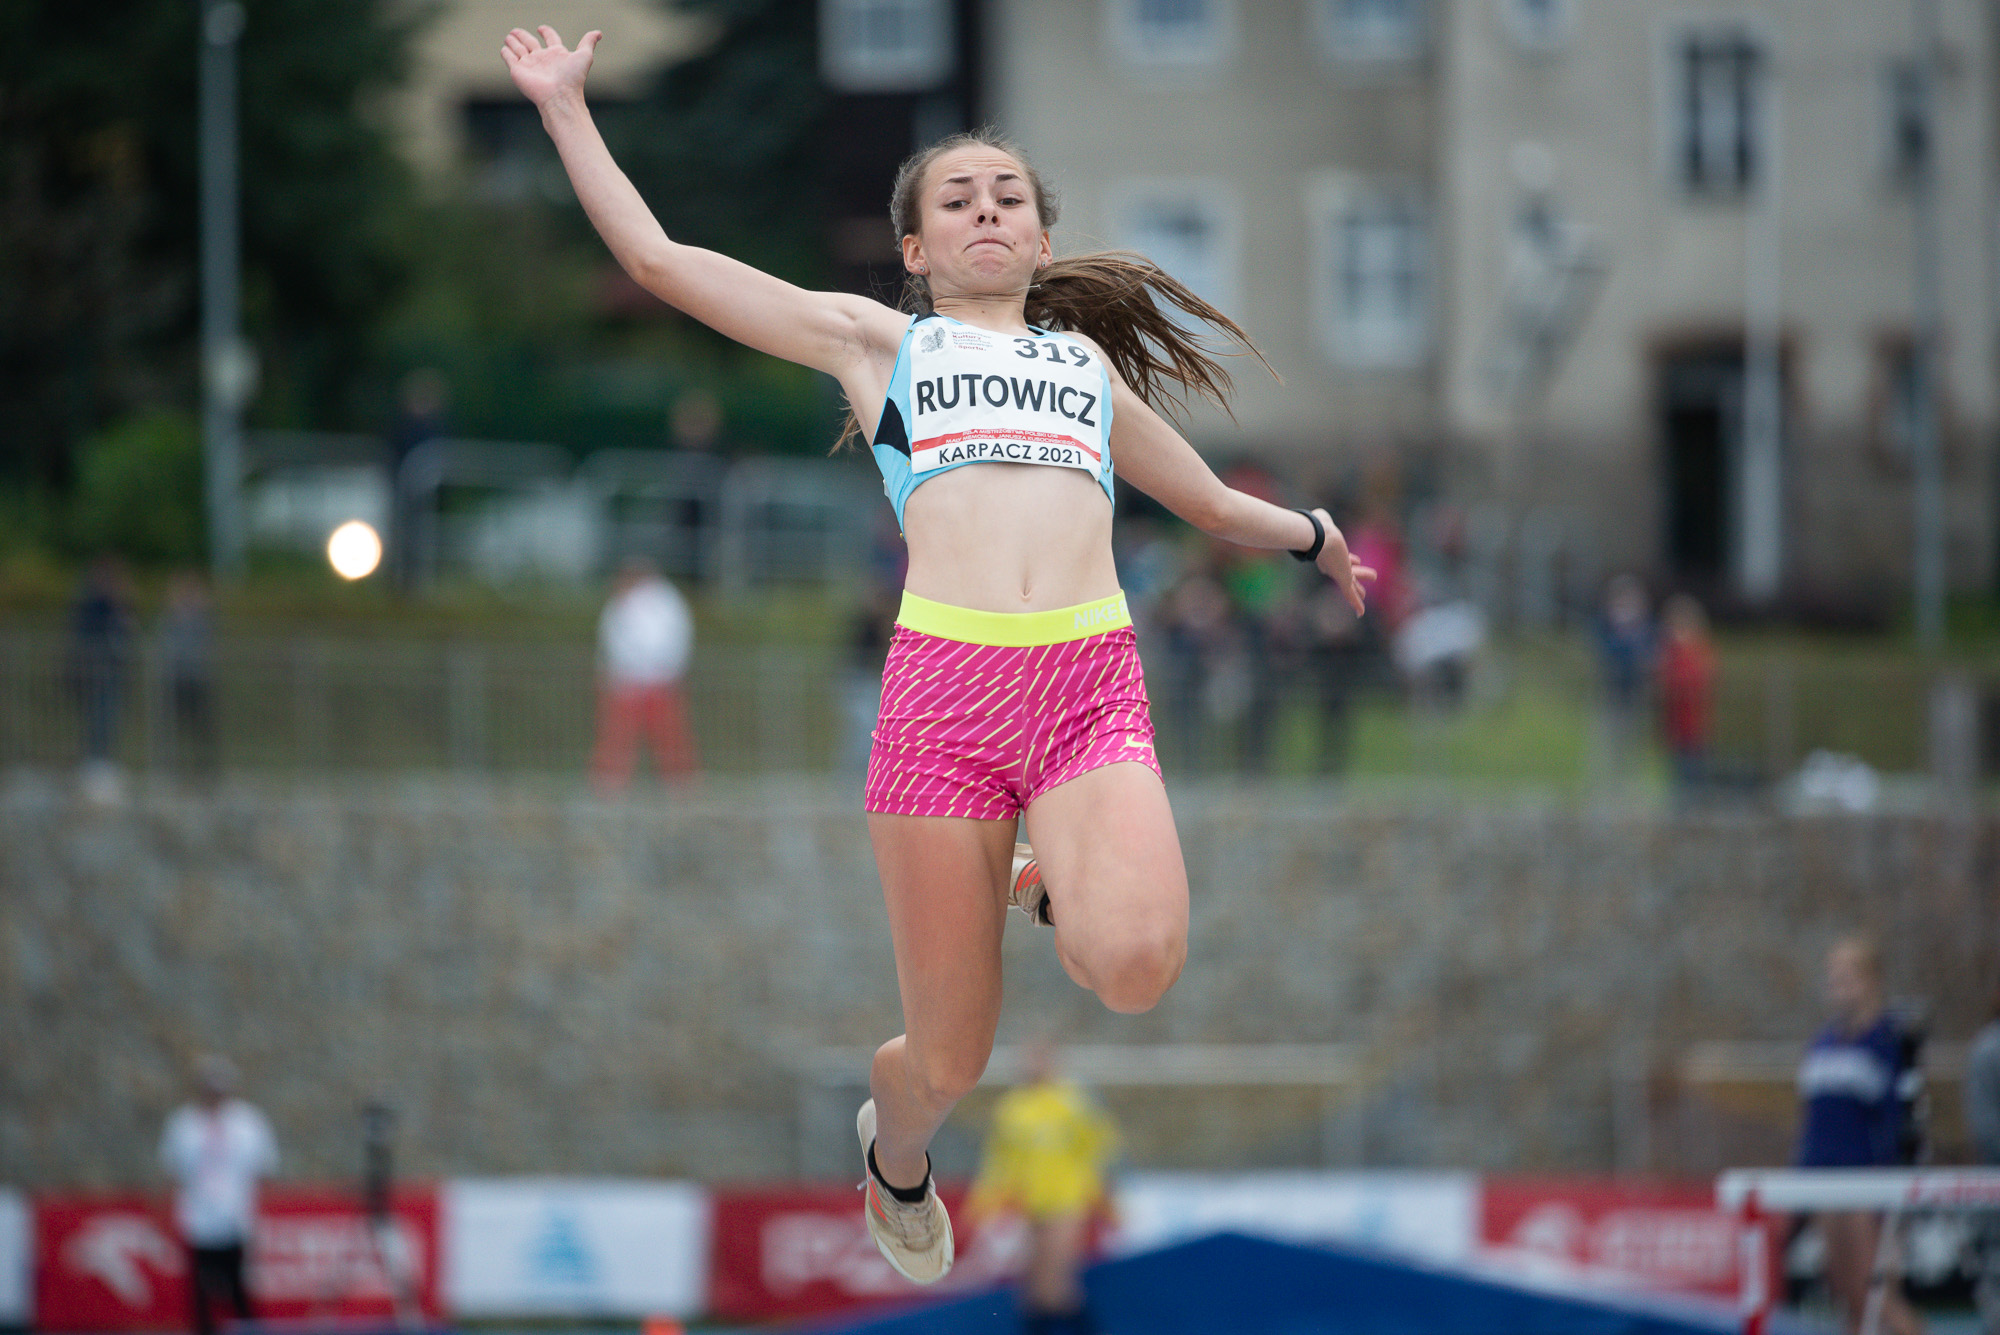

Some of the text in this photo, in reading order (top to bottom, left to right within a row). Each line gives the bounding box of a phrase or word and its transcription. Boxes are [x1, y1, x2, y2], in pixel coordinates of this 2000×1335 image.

[1013, 338, 1090, 367] 319
[916, 374, 1096, 427] RUTOWICZ
[939, 443, 1082, 464] KARPACZ 2021
[1073, 602, 1118, 630] NIKE
